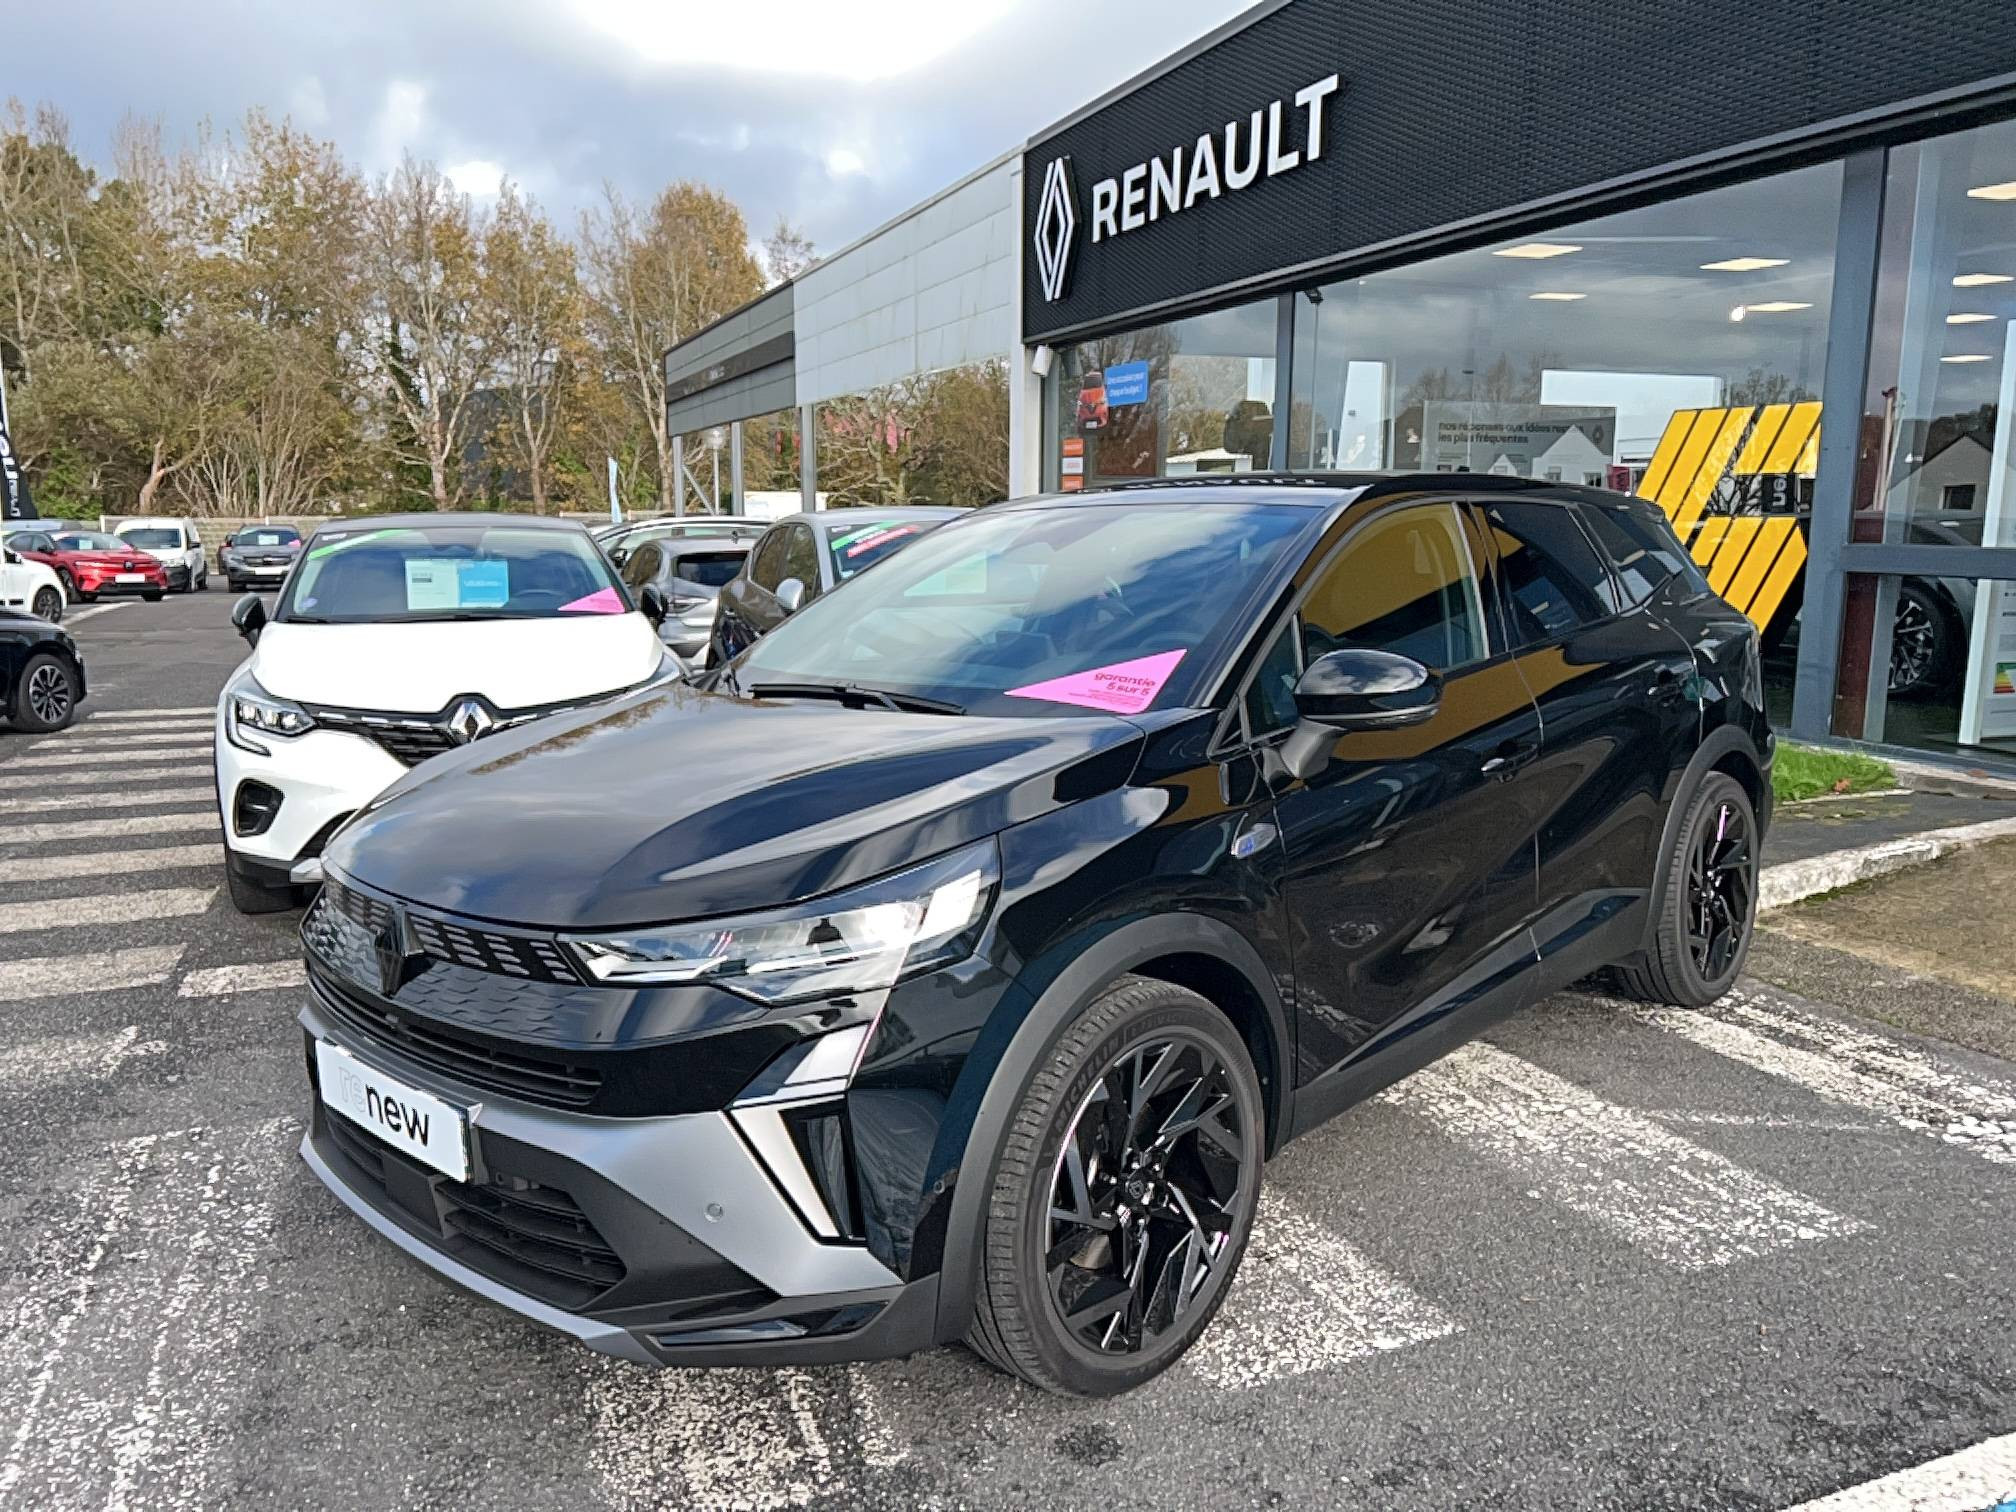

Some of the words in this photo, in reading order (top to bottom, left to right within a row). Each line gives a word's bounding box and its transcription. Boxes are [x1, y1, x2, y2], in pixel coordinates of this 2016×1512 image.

[1092, 73, 1339, 243] RENAULT
[1094, 672, 1156, 687] garantie
[1106, 682, 1116, 690] 5
[1117, 685, 1140, 694] sur
[1141, 687, 1151, 696] 5
[338, 1065, 430, 1148] renew
